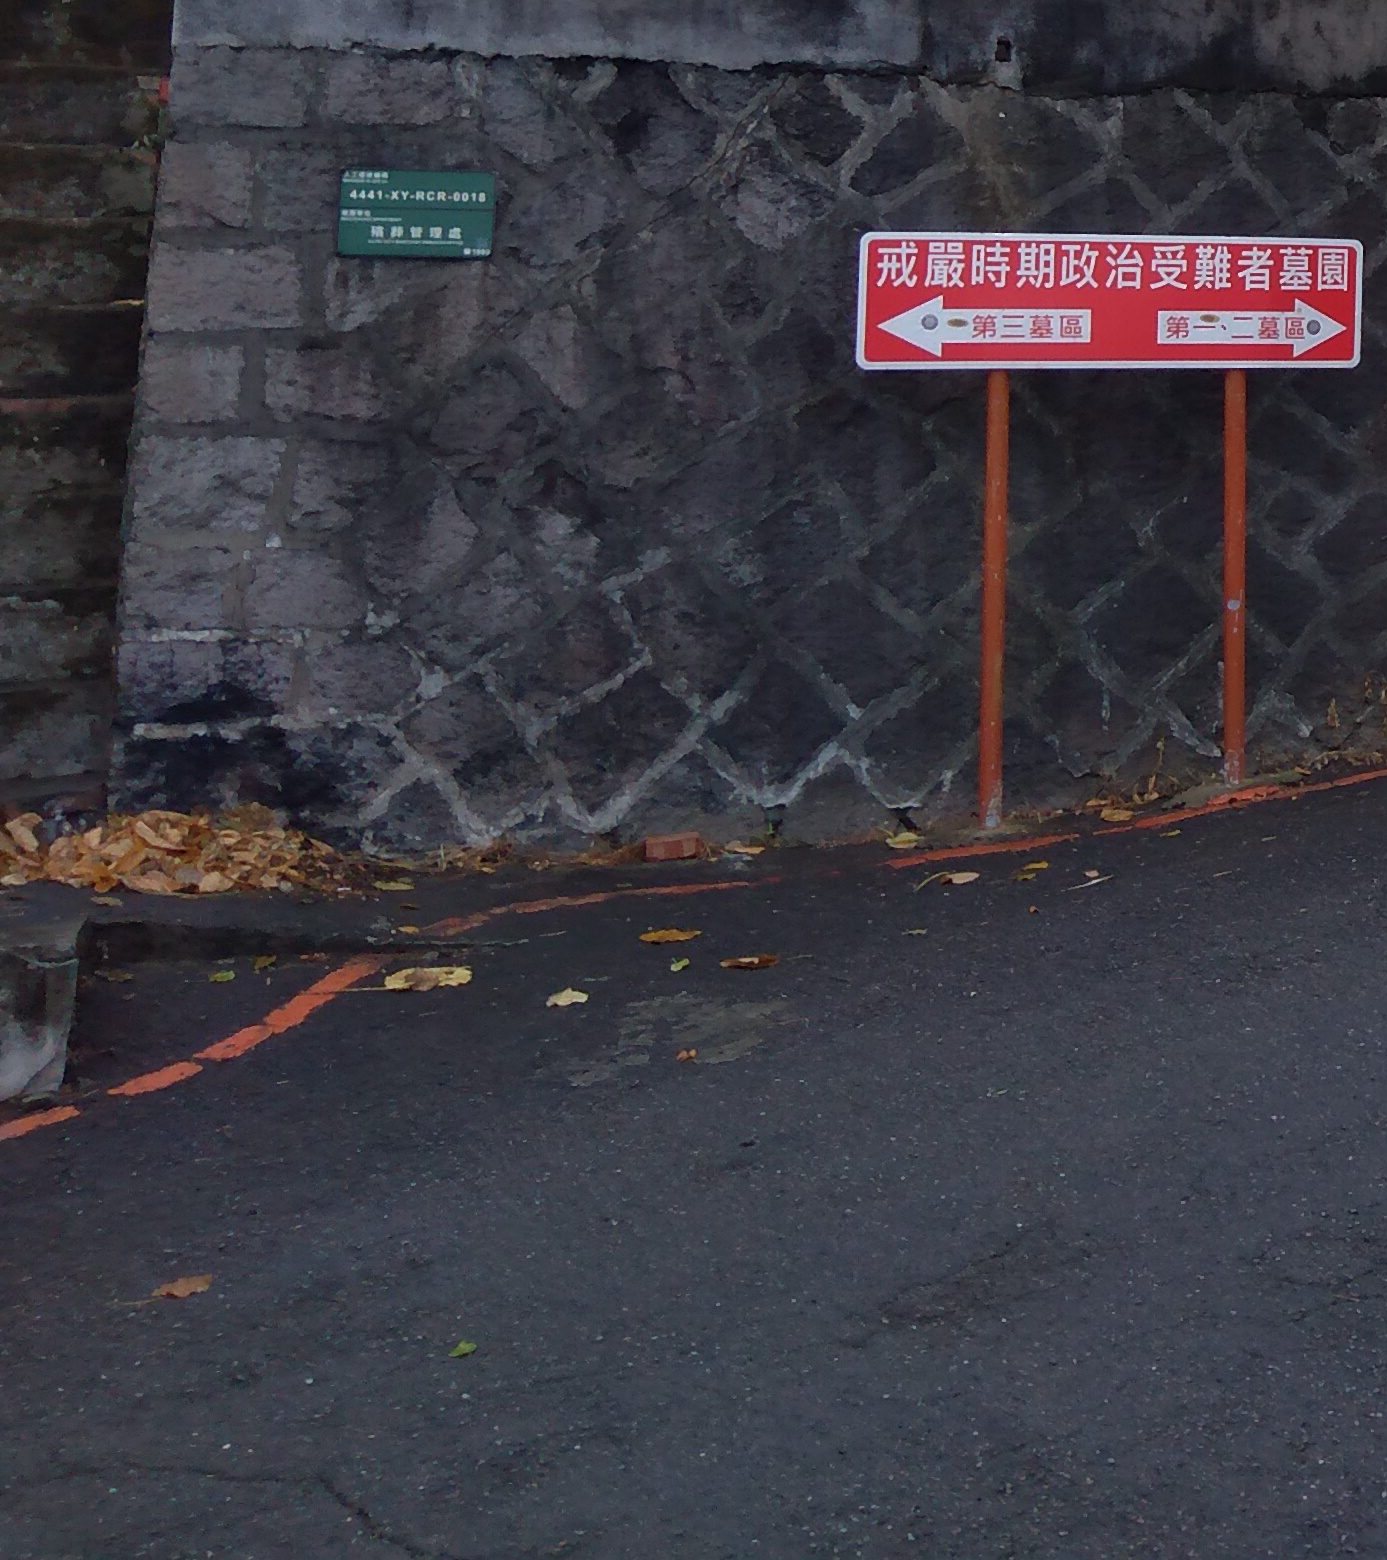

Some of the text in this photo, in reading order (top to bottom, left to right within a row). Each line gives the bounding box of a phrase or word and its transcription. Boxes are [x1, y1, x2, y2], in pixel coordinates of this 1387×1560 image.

[876, 241, 1349, 292] 戒嚴時期政治受難者墓園
[971, 314, 1086, 339] 第三墓區
[1165, 315, 1307, 340] 第一、二墓區
